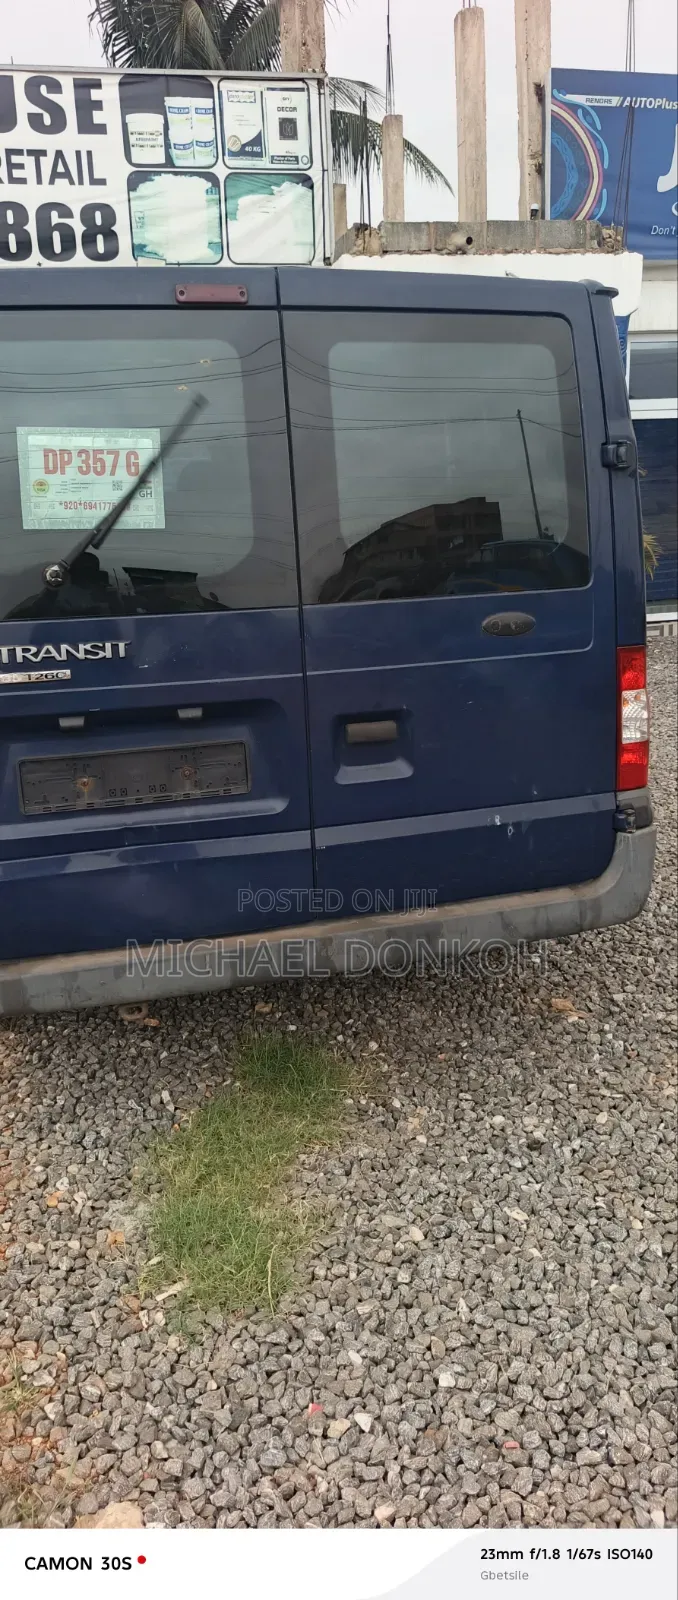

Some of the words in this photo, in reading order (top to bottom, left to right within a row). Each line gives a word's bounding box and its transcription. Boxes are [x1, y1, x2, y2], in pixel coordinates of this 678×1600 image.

[0, 148, 107, 186] ETAIL
[651, 225, 676, 236] Don't
[43, 448, 72, 475] DP
[77, 449, 120, 476] 357
[125, 450, 140, 477] G
[139, 490, 153, 498] GH
[0, 640, 131, 664] TRANSIT
